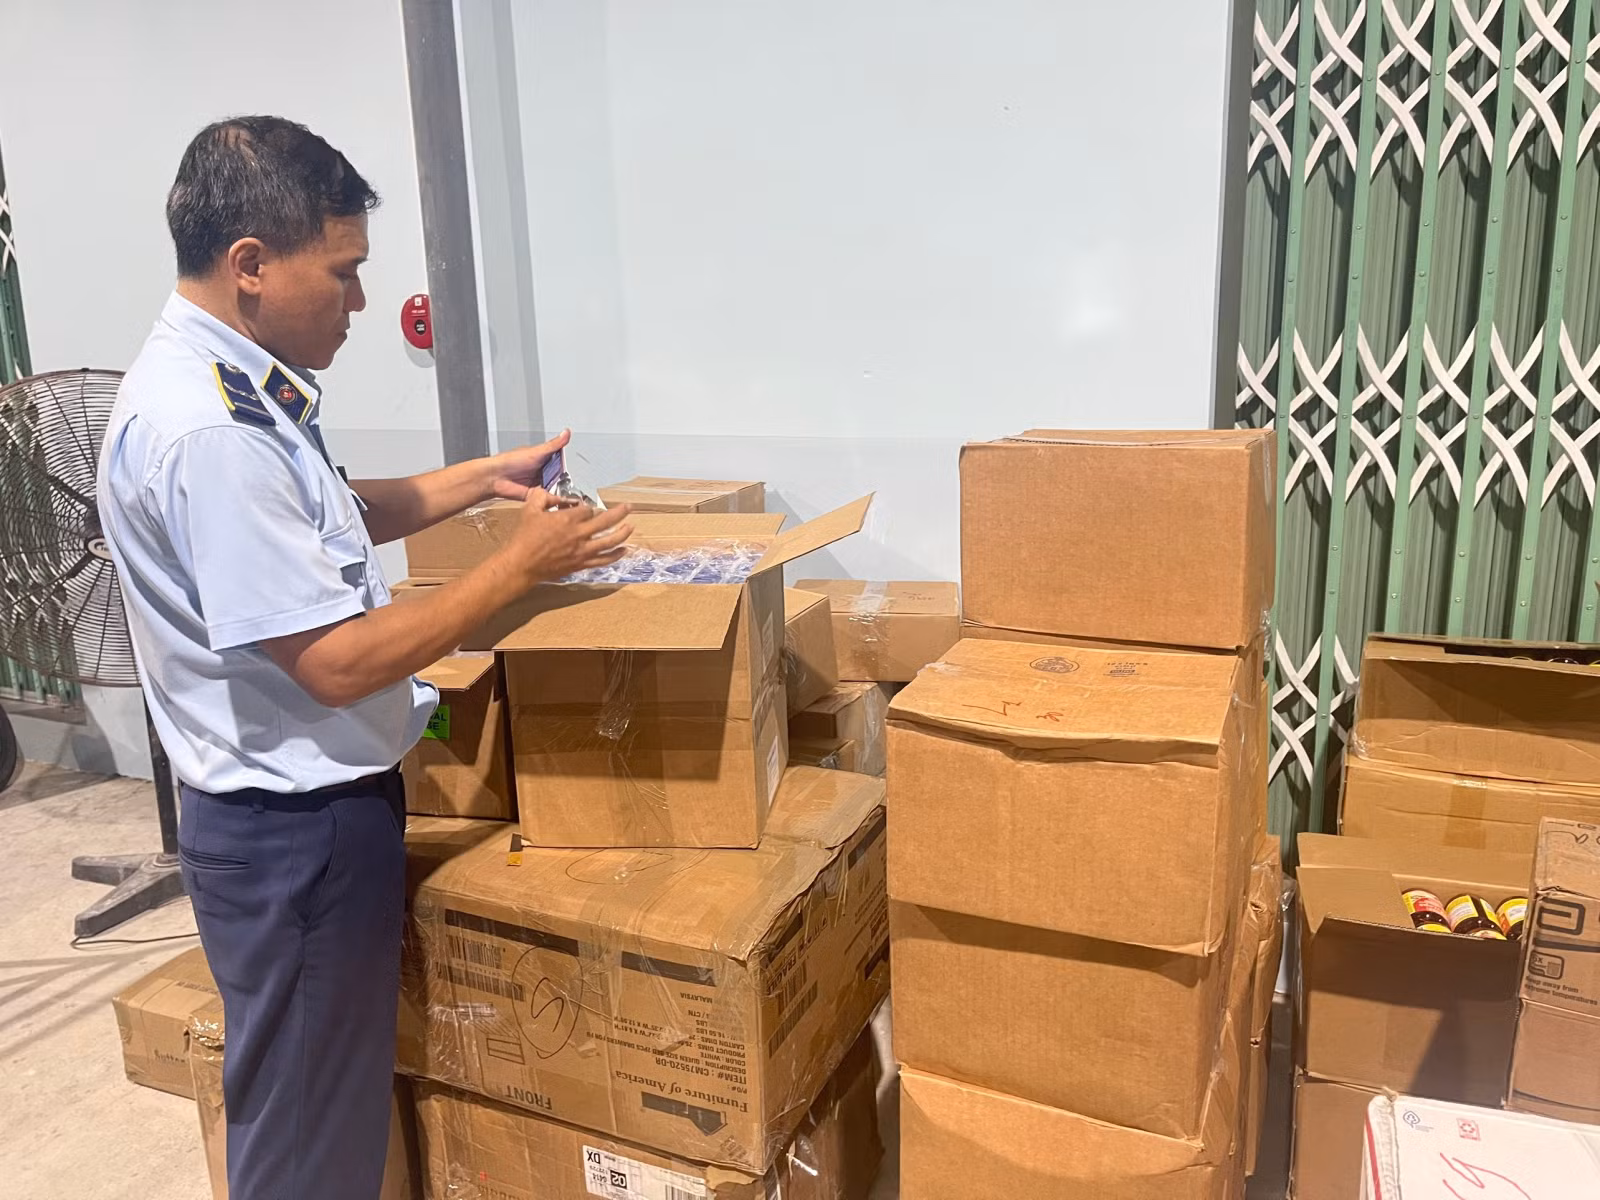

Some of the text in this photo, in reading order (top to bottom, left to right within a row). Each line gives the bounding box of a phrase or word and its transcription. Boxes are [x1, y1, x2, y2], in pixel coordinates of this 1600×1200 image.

[1562, 984, 1579, 993] from
[679, 992, 713, 1004] MALAYSIA
[697, 1043, 715, 1052] DIMS
[718, 1039, 745, 1050] CARTON
[700, 1051, 721, 1061] WHITE
[716, 1048, 746, 1059] PRODUCT
[679, 1055, 700, 1065] QUEEN
[725, 1057, 746, 1067] COLOR
[705, 1060, 747, 1075] DESCRIPTION
[717, 1071, 747, 1085] ITEM#
[615, 1070, 749, 1113] Furniture of America
[504, 1085, 553, 1111] FRONT
[586, 1150, 601, 1165] DX
[610, 1171, 627, 1188] 02
